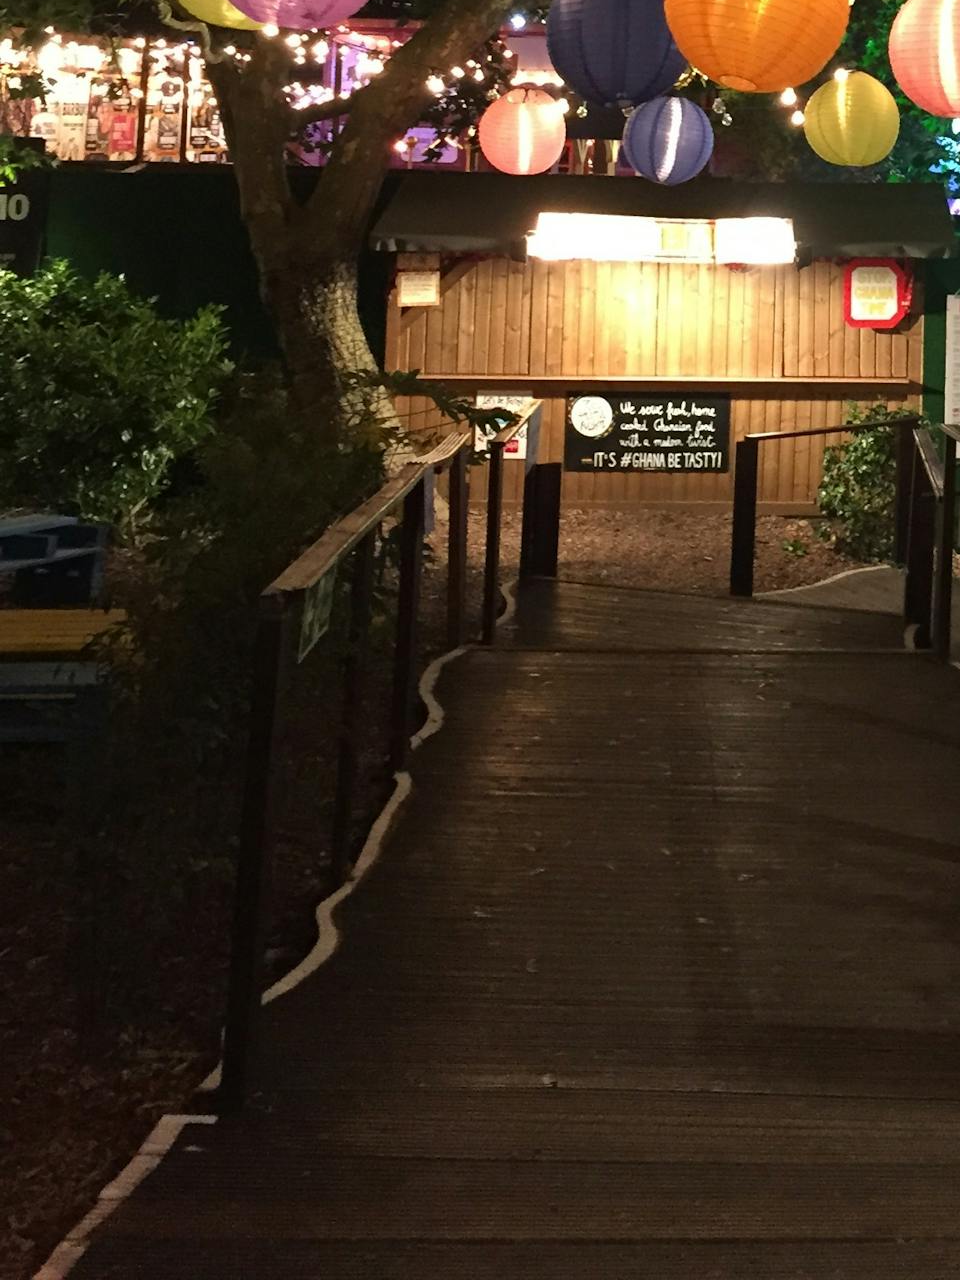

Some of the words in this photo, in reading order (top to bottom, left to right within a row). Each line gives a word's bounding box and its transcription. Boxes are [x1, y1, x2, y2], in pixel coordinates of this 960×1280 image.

[619, 401, 636, 415] We
[619, 433, 642, 448] with
[642, 439, 651, 447] a
[620, 452, 666, 468] #GHANA
[667, 452, 682, 468] BE
[683, 451, 722, 468] TASTY!
